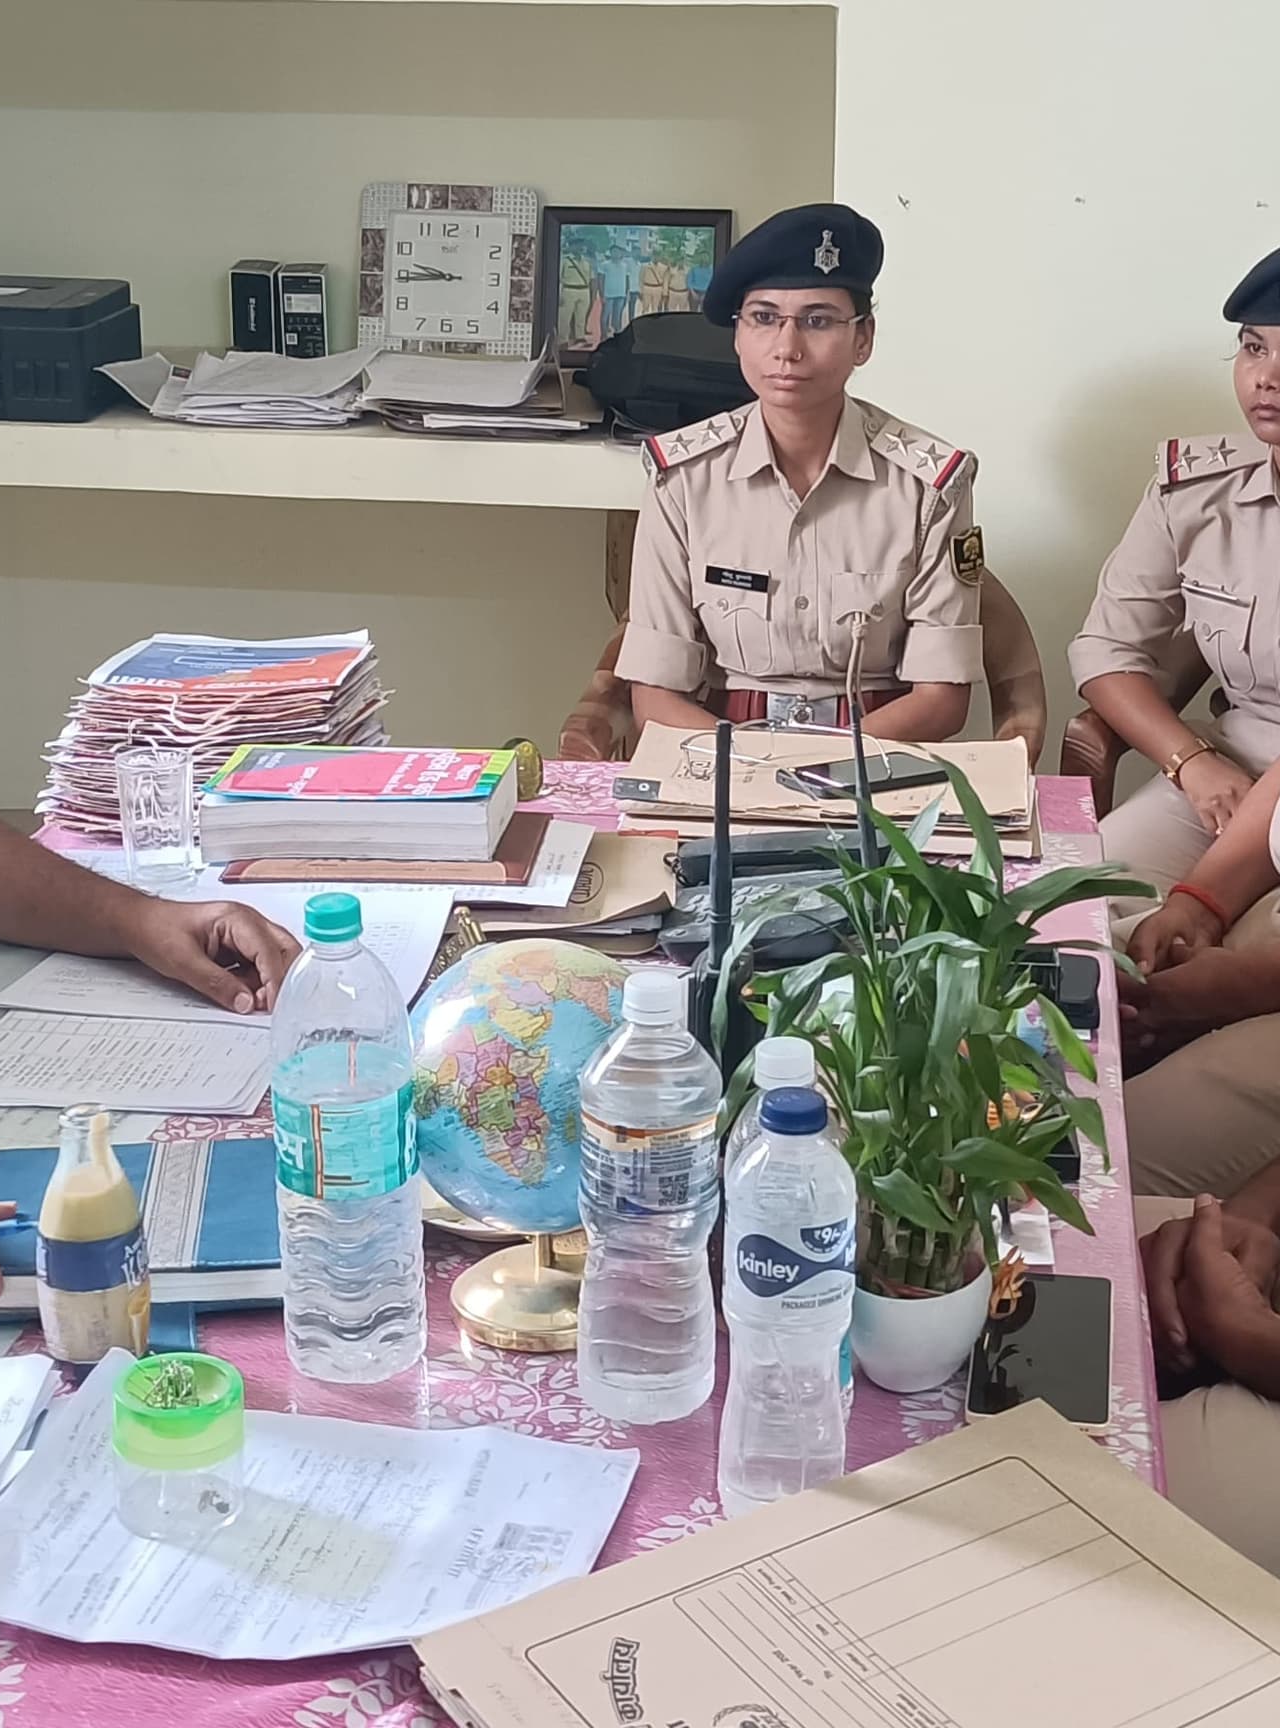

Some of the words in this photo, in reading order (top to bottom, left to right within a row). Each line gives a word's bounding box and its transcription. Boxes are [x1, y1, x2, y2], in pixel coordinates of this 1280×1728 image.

[420, 222, 431, 236] 11
[442, 223, 459, 238] 12
[397, 241, 412, 255] 10
[489, 245, 502, 260] 2
[488, 272, 501, 287] 3
[396, 296, 408, 310] 8
[486, 300, 499, 315] 4
[415, 317, 426, 331] 7
[440, 318, 452, 333] 6
[467, 319, 479, 334] 5
[739, 1250, 799, 1283] kinley
[599, 1637, 644, 1722] कार्यालय
